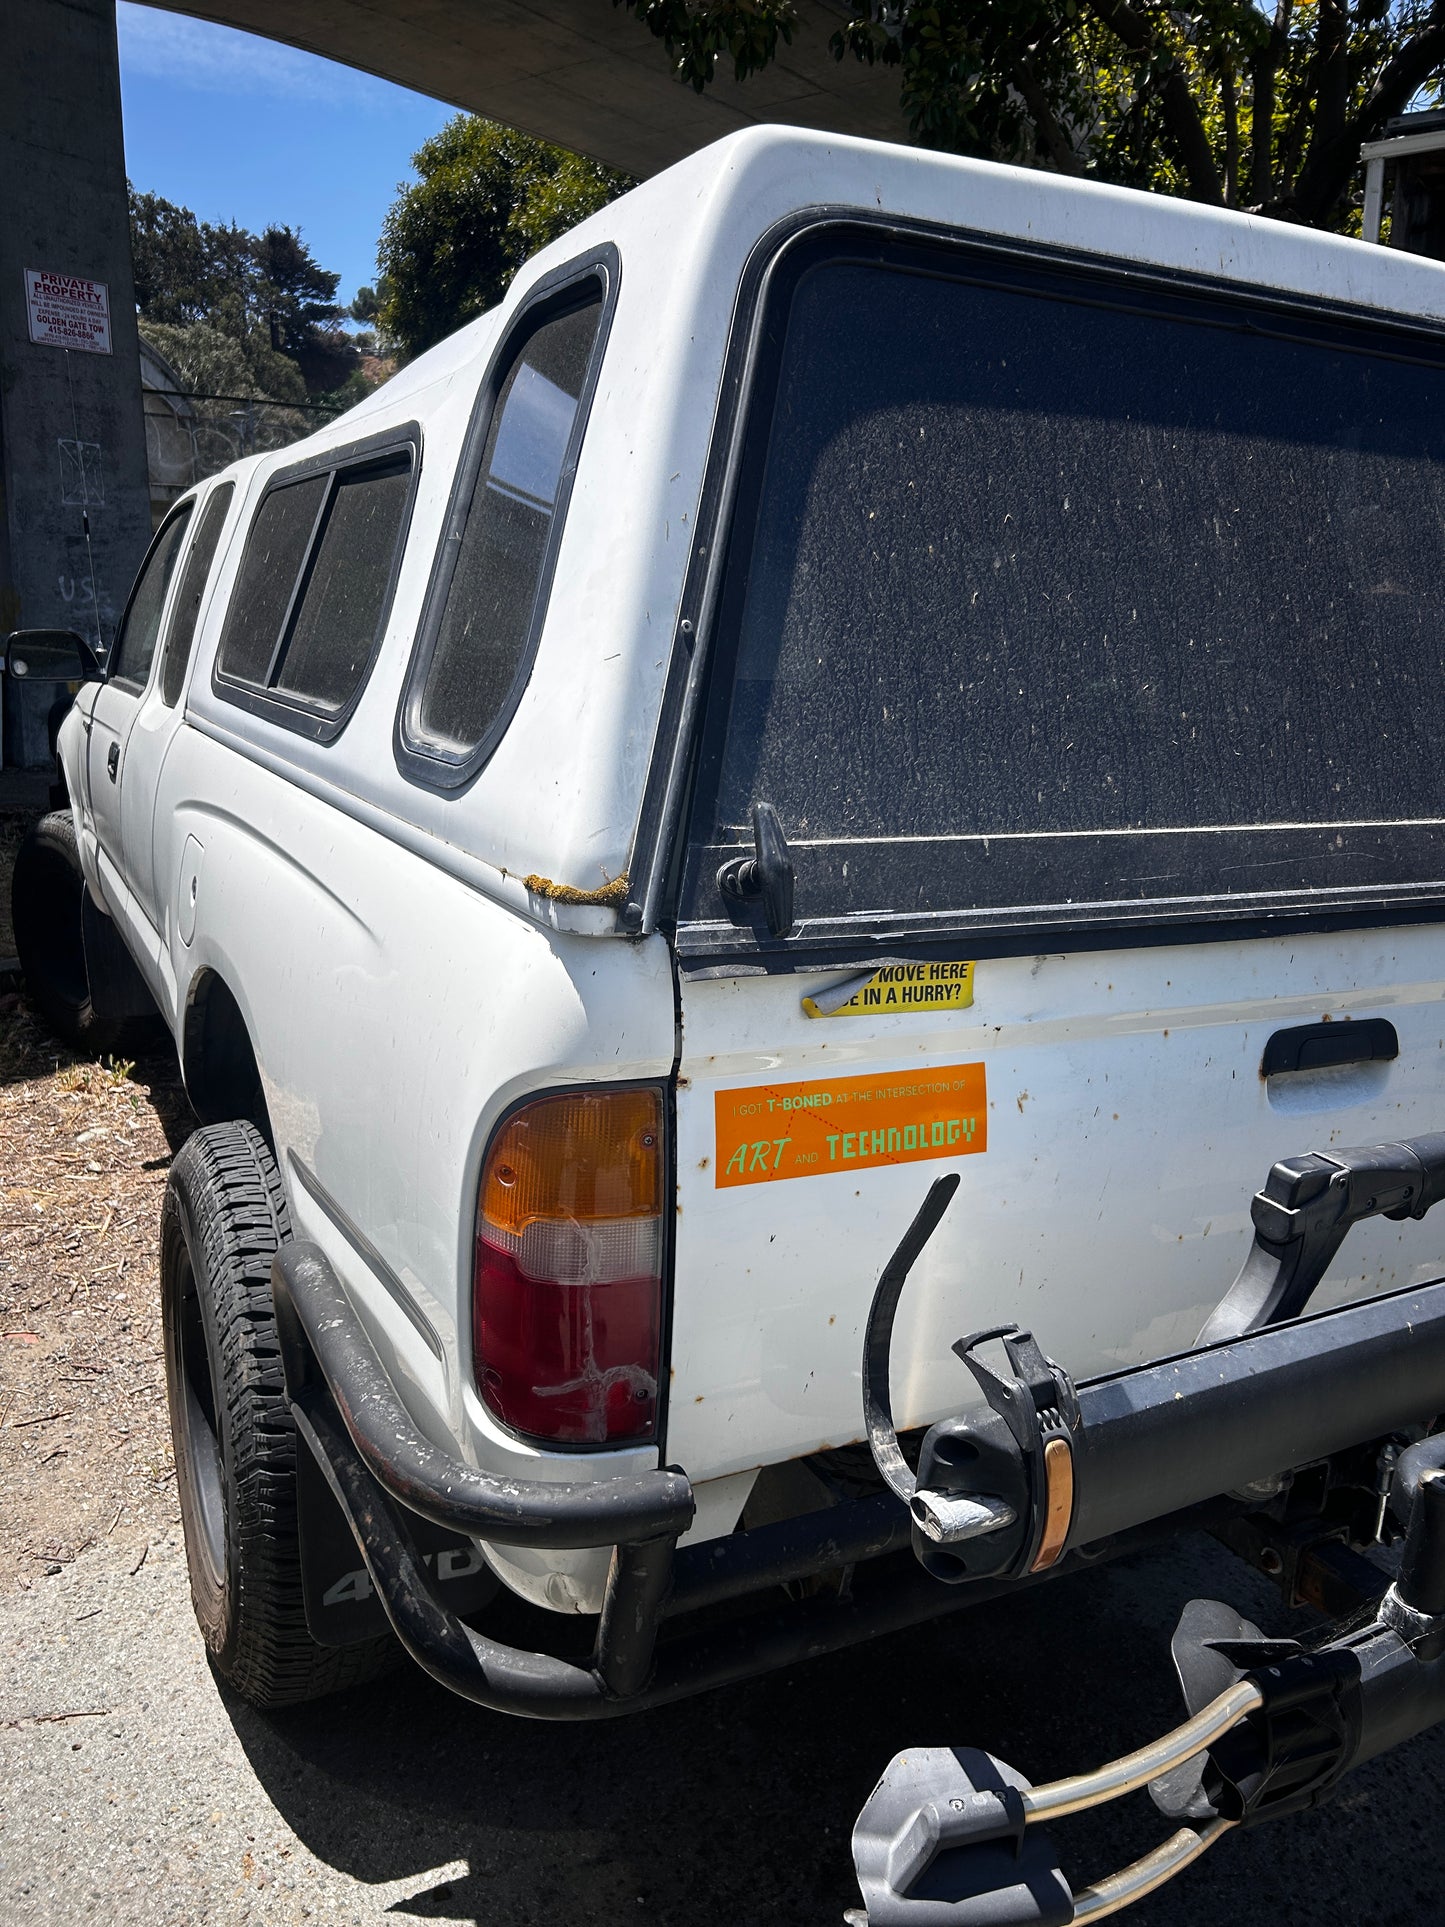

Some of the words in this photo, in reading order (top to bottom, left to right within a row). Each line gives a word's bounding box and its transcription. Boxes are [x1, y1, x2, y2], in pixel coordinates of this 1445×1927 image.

[34, 282, 101, 303] PROPERTY
[41, 273, 94, 292] PRIVATE
[44, 294, 81, 307] UNAUTHORIZED
[82, 302, 104, 311] VEHICLES
[36, 315, 67, 327] GOLDEN
[68, 320, 87, 331] GATE
[89, 323, 104, 334] TOW
[878, 965, 925, 983] MOVE
[929, 963, 968, 980] HERE
[863, 987, 881, 1005] IN
[885, 986, 900, 1004] A
[902, 983, 962, 1003] HURRY?
[739, 1103, 763, 1116] GOT
[766, 1093, 833, 1113] T-BONED
[836, 1093, 850, 1104] AT
[852, 1090, 873, 1103] THE
[875, 1081, 950, 1100] INTERSECTION
[952, 1080, 966, 1092] OF
[726, 1137, 792, 1175] ART
[794, 1152, 818, 1165] AND
[826, 1118, 976, 1160] TECHNOLOGY
